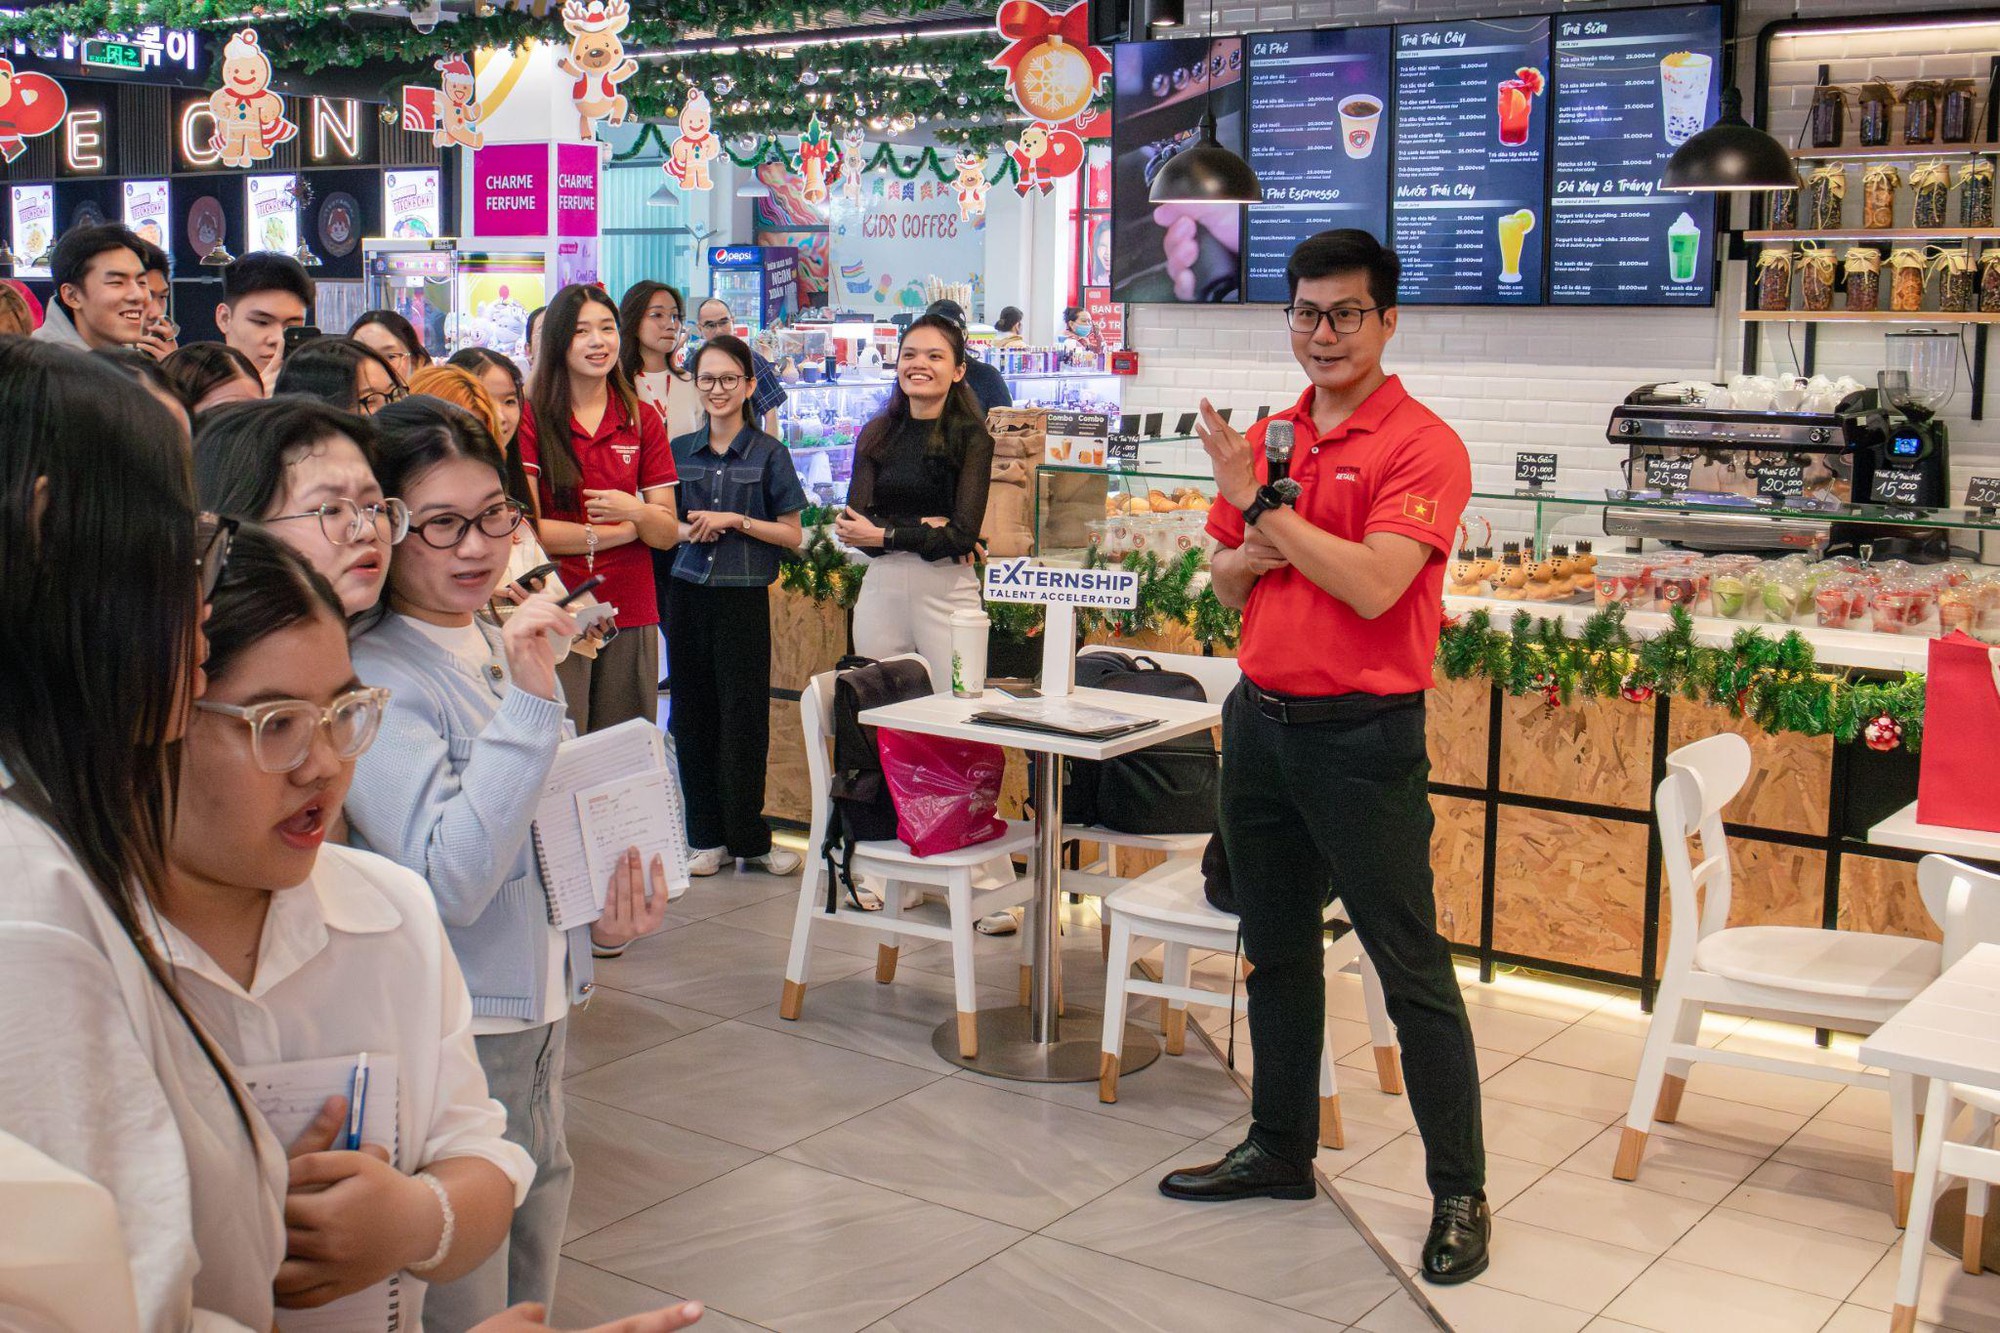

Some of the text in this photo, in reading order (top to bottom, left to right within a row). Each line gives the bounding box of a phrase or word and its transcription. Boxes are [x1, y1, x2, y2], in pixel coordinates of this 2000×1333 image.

[1562, 22, 1608, 36] Trà Sữa
[1401, 32, 1466, 47] Trà Trái Cây
[1254, 42, 1289, 55] Cà Phê
[486, 174, 534, 190] CHARME
[558, 174, 594, 188] CHARME
[1557, 181, 1574, 193] Đá
[1578, 181, 1600, 196] Xay
[1602, 180, 1614, 192] &
[1618, 179, 1654, 197] Tráng
[1267, 186, 1340, 200] Phê Espresso
[1397, 184, 1476, 200] Nước Trái Cây
[486, 196, 536, 210] FERFUME
[558, 195, 594, 210] FERFUME
[862, 214, 958, 238] KIDS COFFEE
[728, 251, 752, 261] pepsi
[1048, 414, 1104, 422] Combo Combo
[989, 560, 1134, 592] EXTERNSHIP
[989, 589, 1130, 604] TALENT ACCELERATOR
